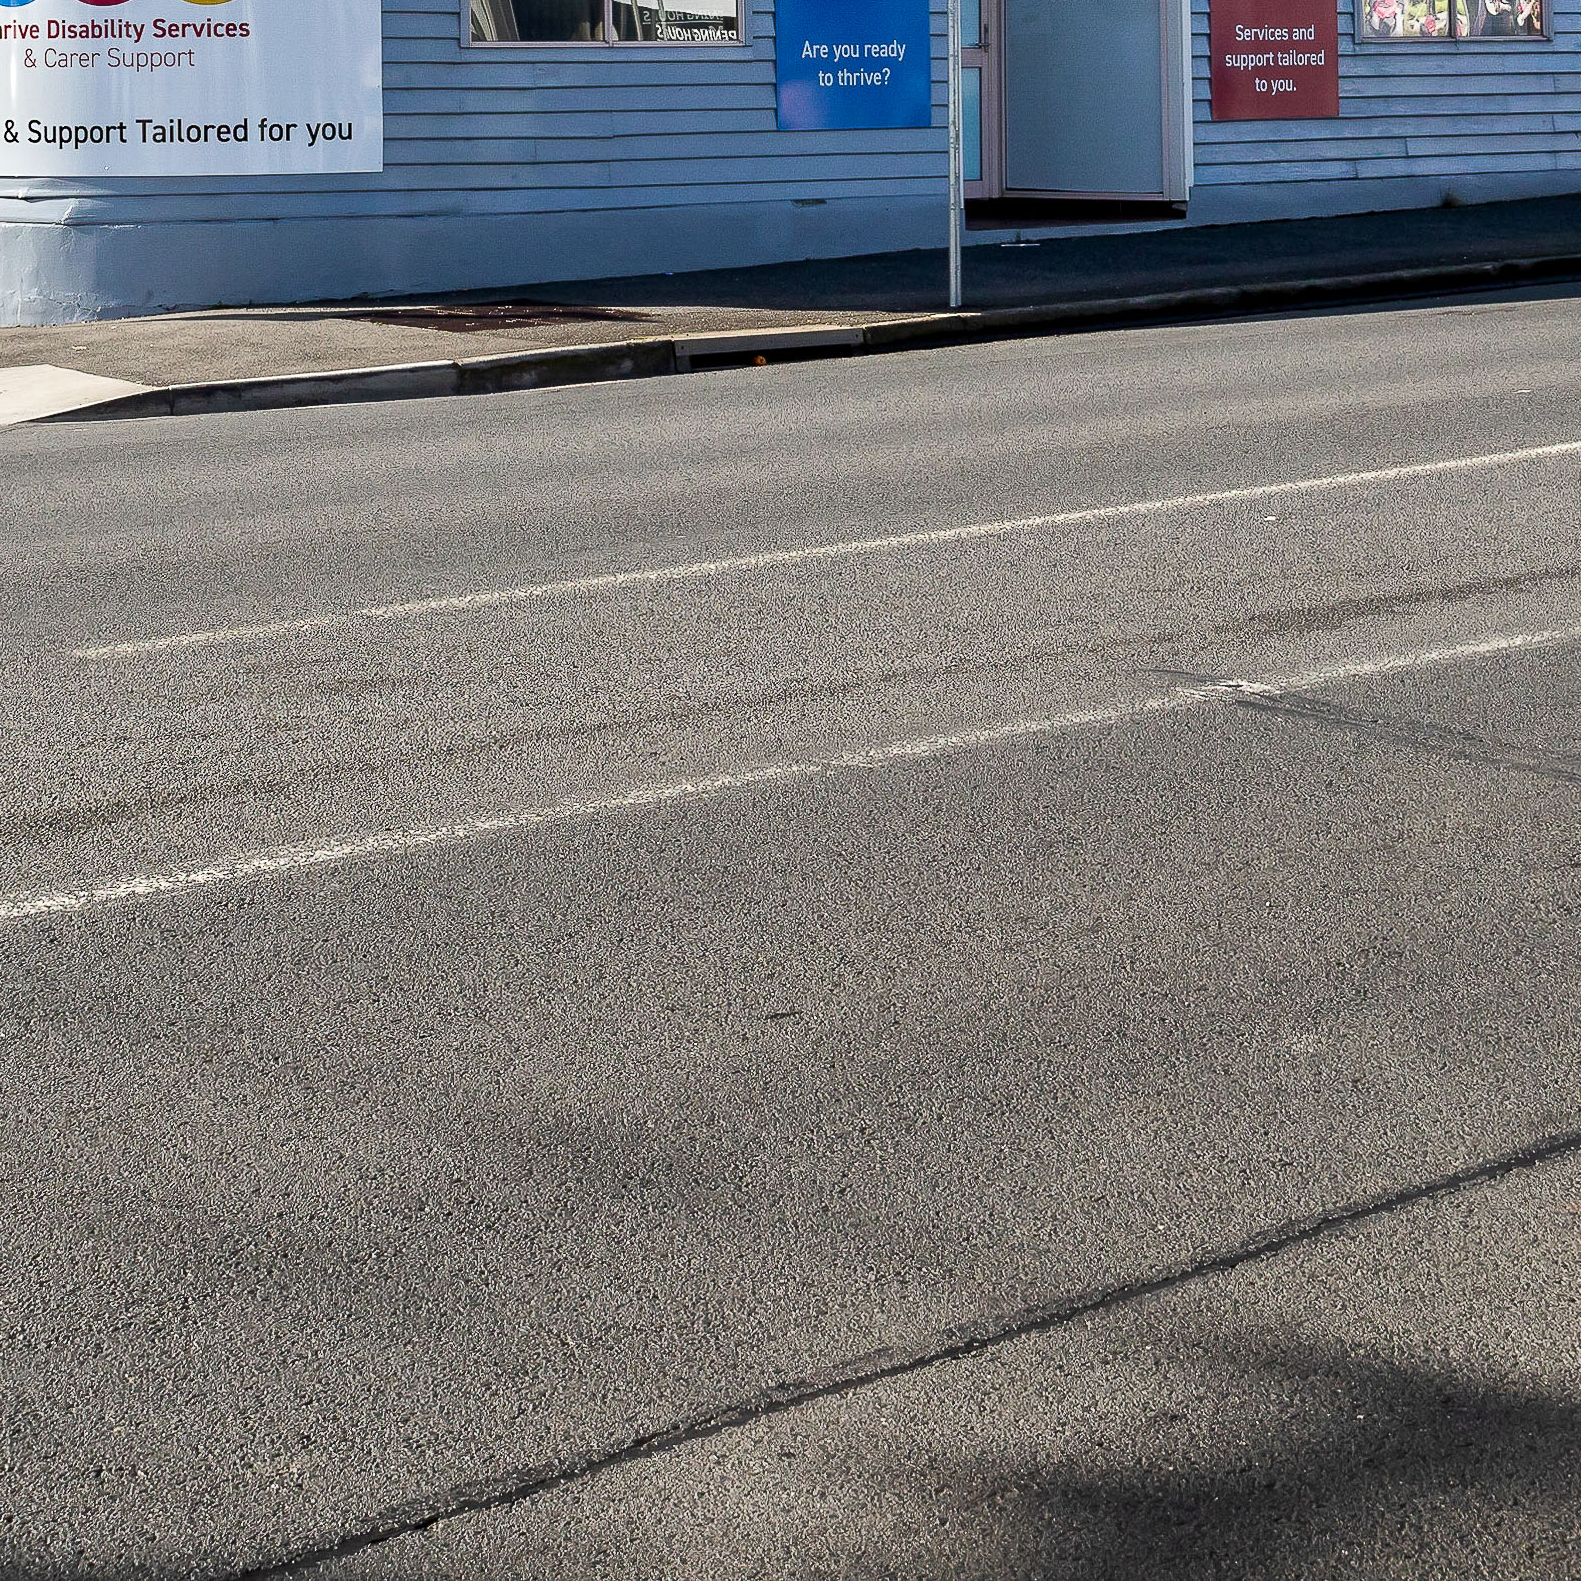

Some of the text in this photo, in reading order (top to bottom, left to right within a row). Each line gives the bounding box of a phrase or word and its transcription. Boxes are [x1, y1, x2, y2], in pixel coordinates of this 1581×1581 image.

[47, 19, 146, 43] Disability
[152, 18, 251, 39] Services
[1235, 24, 1315, 41] Services and
[24, 47, 195, 72] & Carer Support
[801, 39, 906, 63] Are you ready
[1225, 49, 1325, 70] support tailored
[818, 67, 890, 86] to thrive?
[1255, 77, 1297, 96] to you.
[4, 119, 19, 143] &
[28, 119, 127, 150] Support
[136, 118, 248, 143] Tailored
[258, 117, 298, 142] for
[306, 122, 353, 147] you
